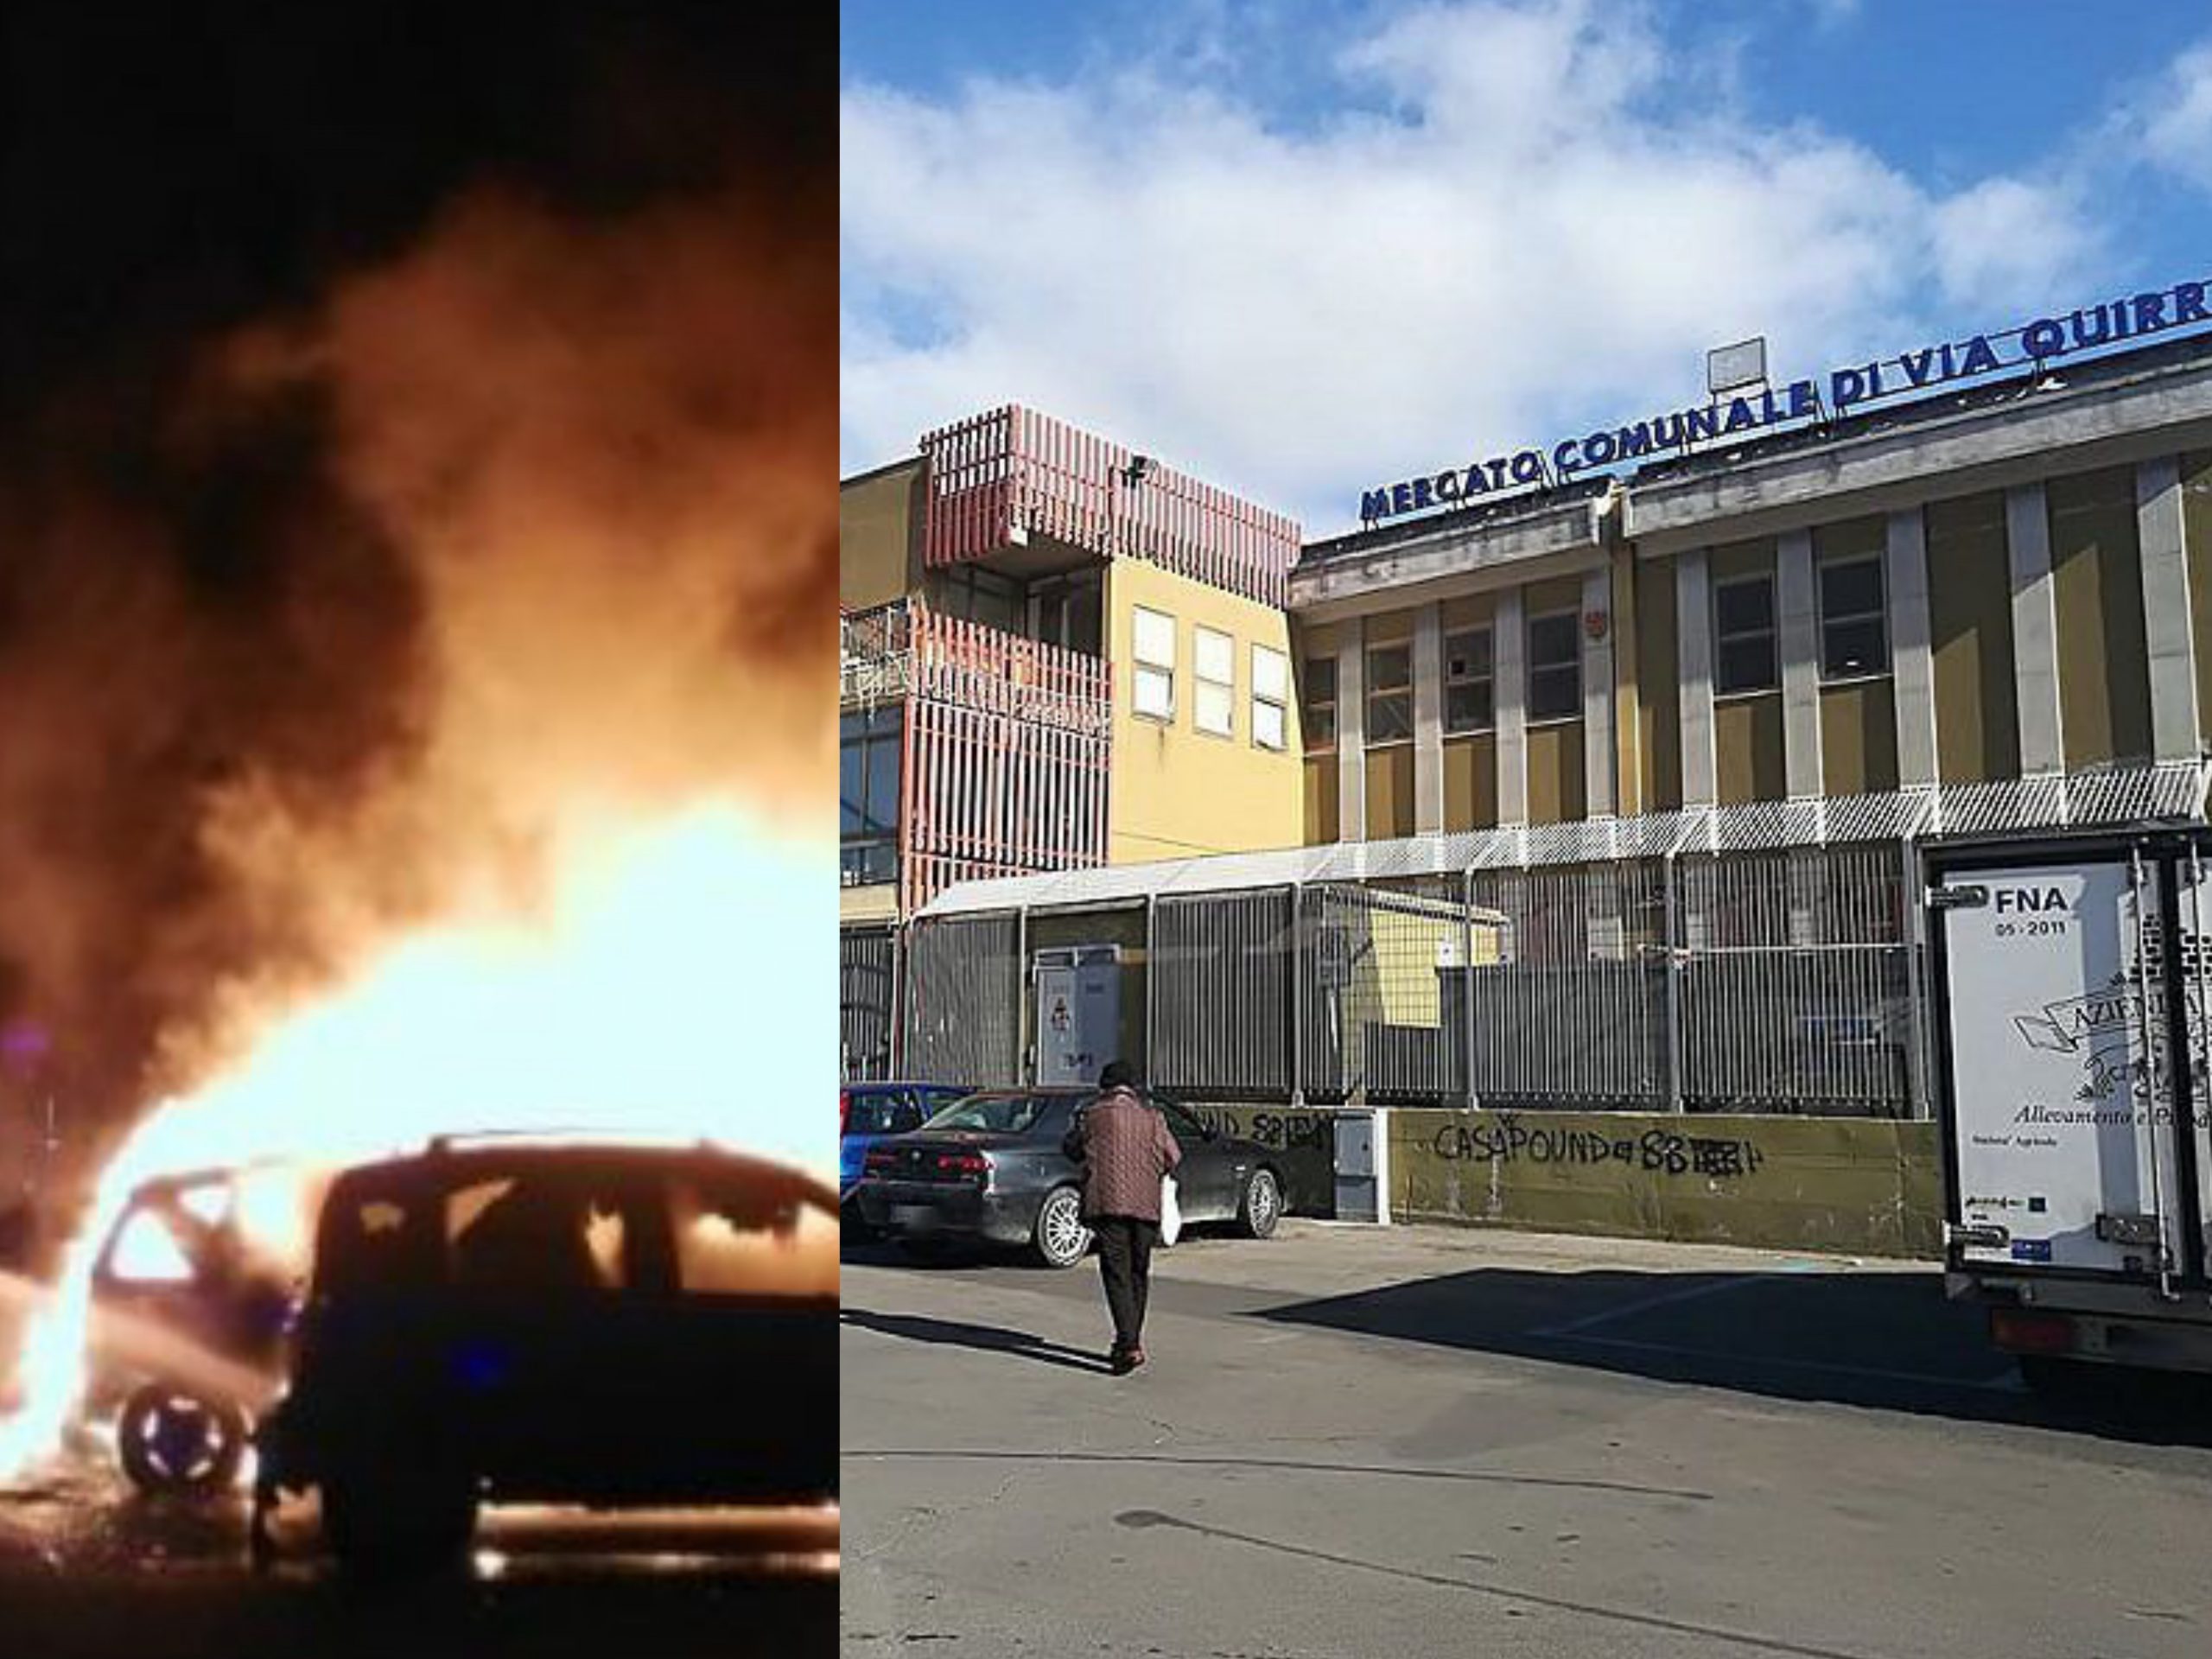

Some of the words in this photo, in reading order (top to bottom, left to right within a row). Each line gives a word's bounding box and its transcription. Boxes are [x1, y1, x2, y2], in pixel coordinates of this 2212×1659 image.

[1361, 452, 1538, 519] MERCATO
[1554, 380, 1815, 468] COMUNALE
[1831, 362, 1882, 406] DI
[1901, 335, 1999, 386] VIA
[2023, 282, 2206, 358] QUIRR
[1995, 887, 2068, 914] FNA
[1433, 1125, 1611, 1165] CASAPOUND
